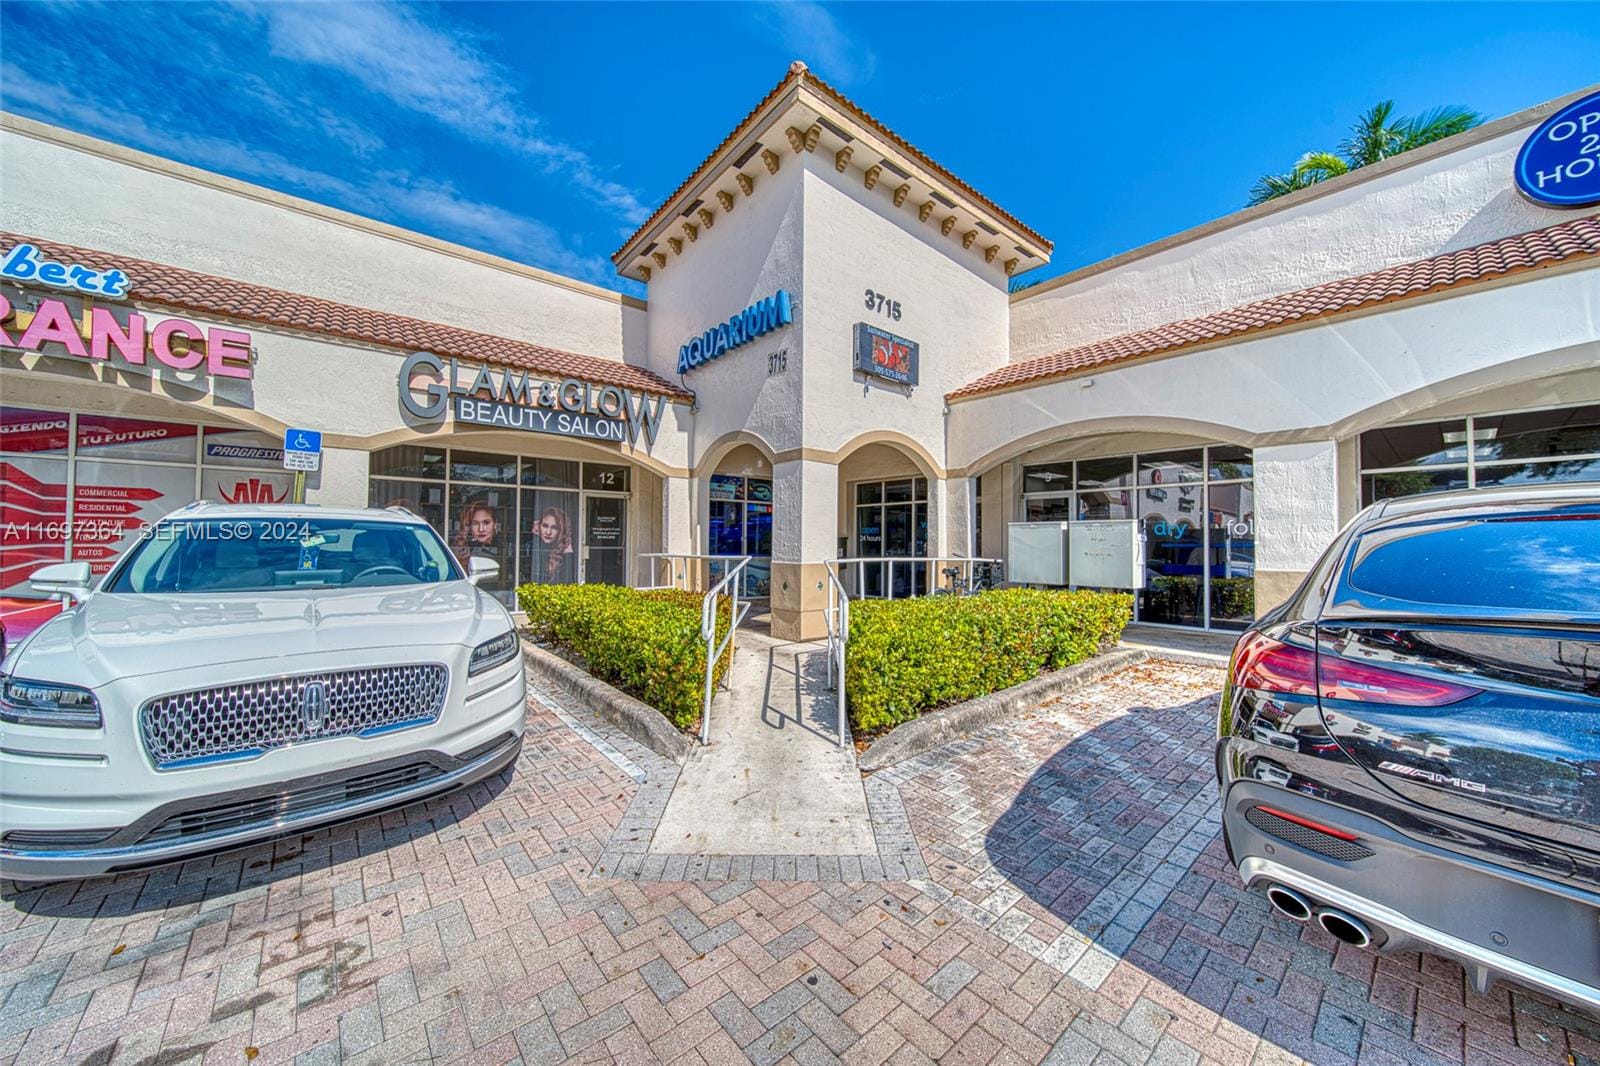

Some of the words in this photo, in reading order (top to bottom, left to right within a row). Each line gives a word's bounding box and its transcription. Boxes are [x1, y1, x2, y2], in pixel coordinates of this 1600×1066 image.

[1536, 153, 1600, 188] HO
[864, 288, 902, 322] 3715
[677, 289, 793, 375] AQUARIUM
[768, 350, 787, 375] 3715
[459, 399, 552, 430] BEAUTY
[557, 413, 624, 440] SALON
[81, 436, 101, 445] TU
[105, 428, 167, 442] FUTURO
[599, 472, 615, 485] 12
[79, 488, 129, 498] COMMERCIAL
[78, 503, 127, 512] RESIDENTIAL
[1154, 520, 1187, 539] dry
[77, 549, 103, 557] AUTOS
